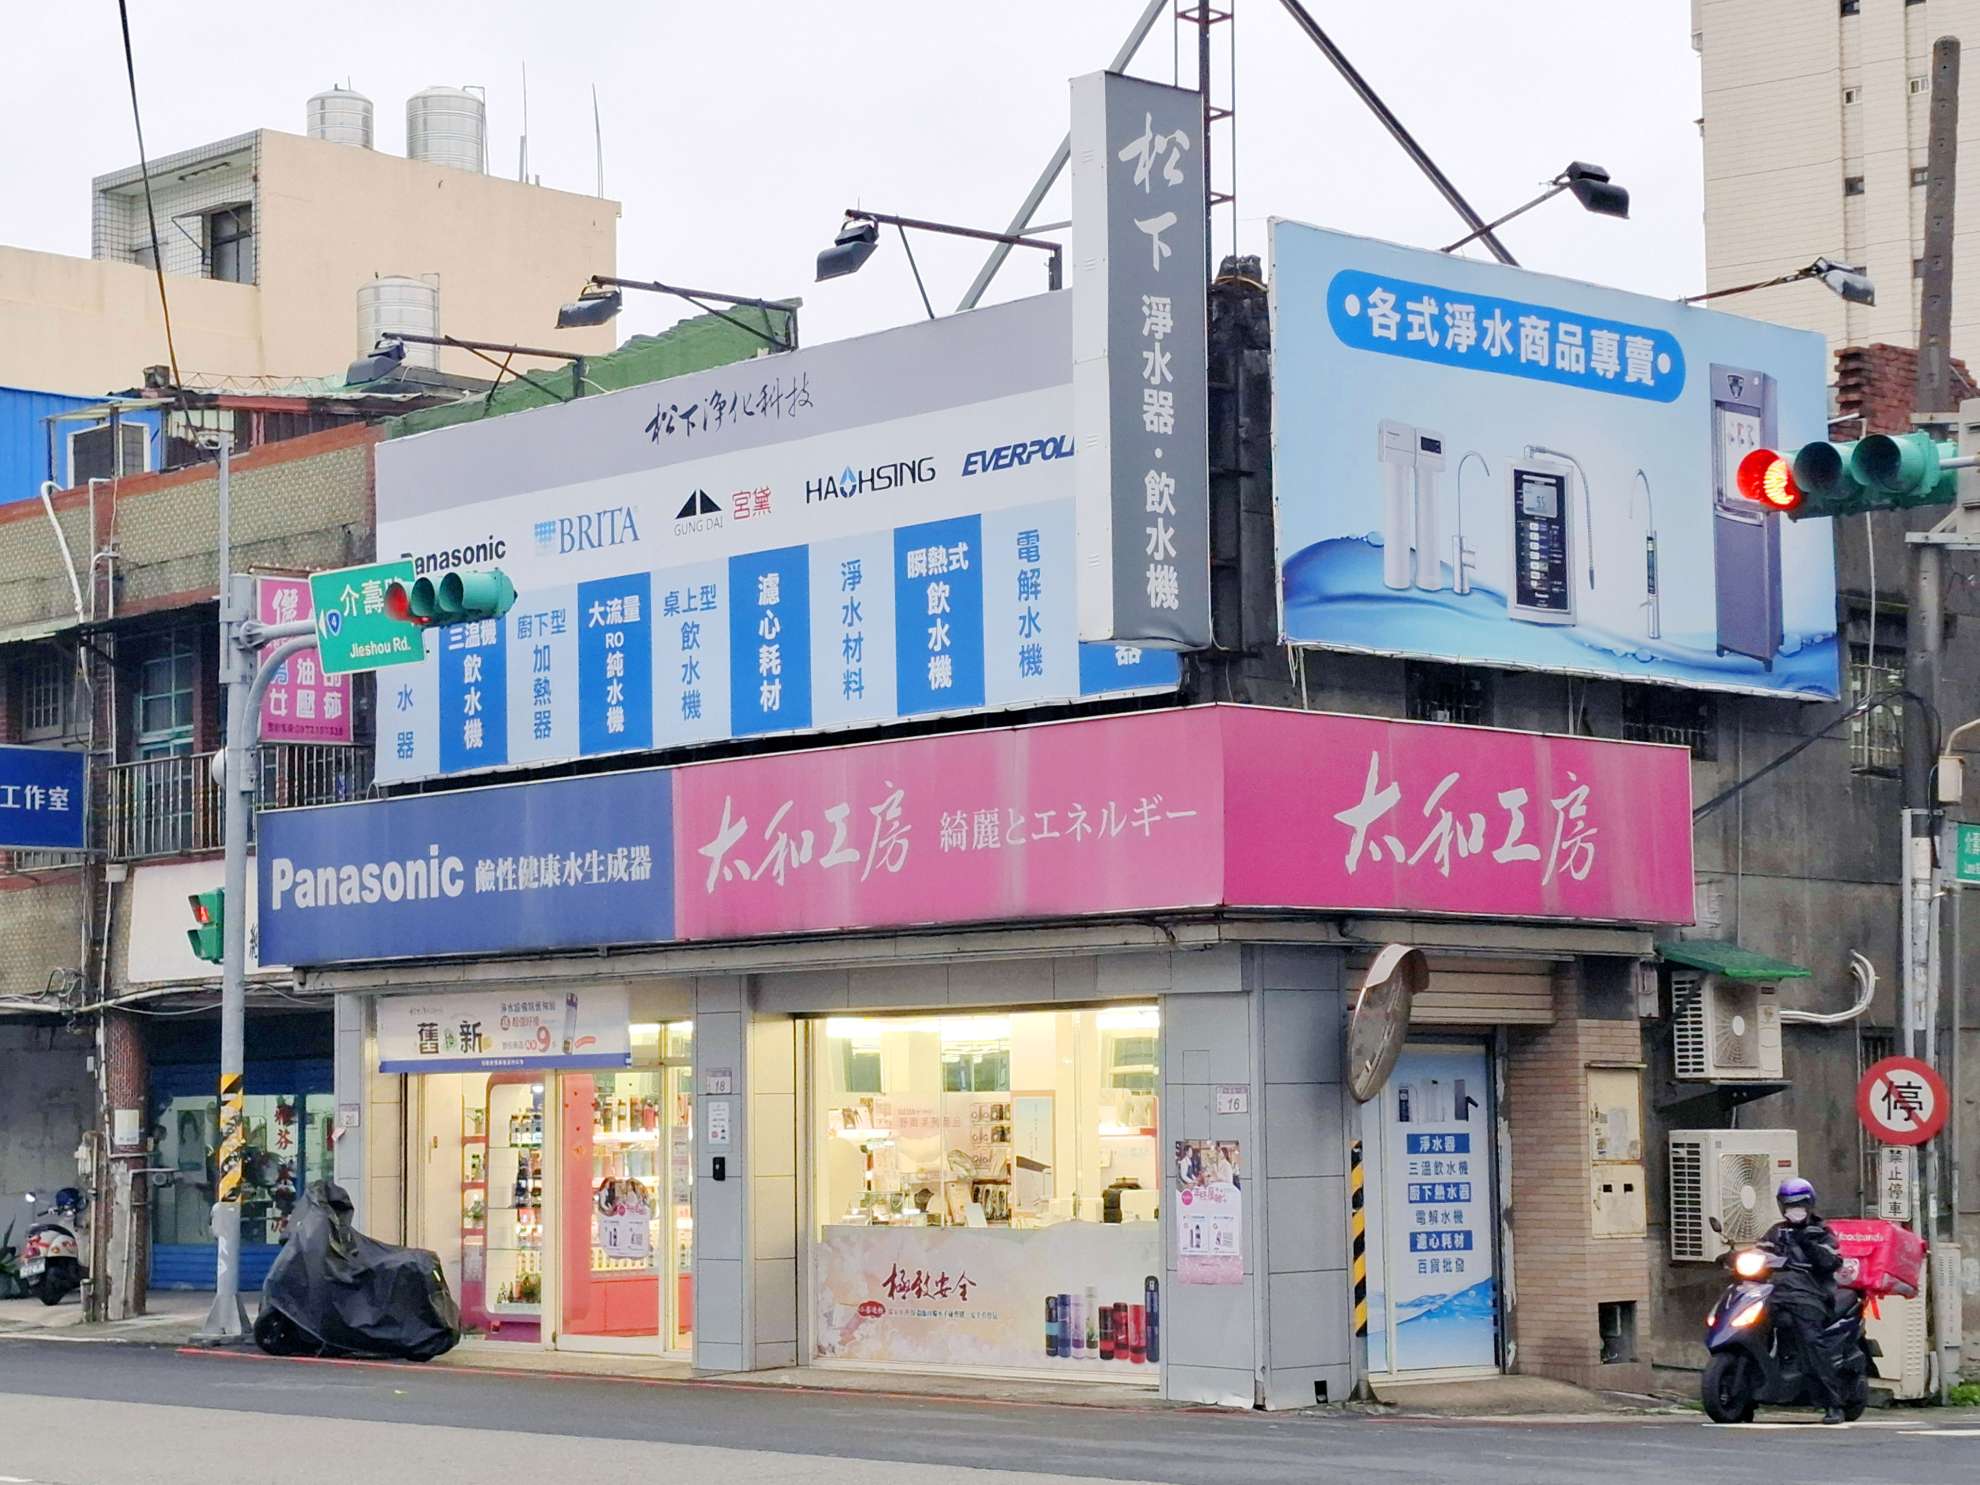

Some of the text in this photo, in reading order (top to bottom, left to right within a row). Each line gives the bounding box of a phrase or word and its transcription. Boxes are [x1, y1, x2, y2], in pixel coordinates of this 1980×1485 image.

[1365, 286, 1656, 388] 各式淨水商品專賣
[961, 434, 1075, 477] EVERPOL
[558, 505, 640, 554] BRITA
[674, 515, 724, 537] GUNG DAI
[401, 534, 507, 576] anasonic
[340, 575, 400, 617] 介壽
[588, 595, 641, 628] 大流量
[663, 584, 718, 617] 桌上型
[1016, 529, 1043, 679] 電解水機
[350, 635, 411, 659] Jieshou Rd.
[758, 573, 782, 712] 濾心耗材
[841, 559, 865, 701] 淨水材料
[927, 581, 953, 690] 飲水機
[533, 645, 552, 740] 加熱器
[681, 620, 702, 721] 飲水機
[464, 654, 483, 750] 飲水機
[939, 793, 1198, 852] 綺麗とエネルギー
[272, 844, 464, 910] Panasonic
[475, 845, 652, 893] 鹼性健康水生成器
[1228, 1097, 1241, 1111] 16
[1882, 1081, 1923, 1121] 停
[1419, 1135, 1456, 1152] 淨水器
[1888, 1149, 1904, 1216] 禁止停車
